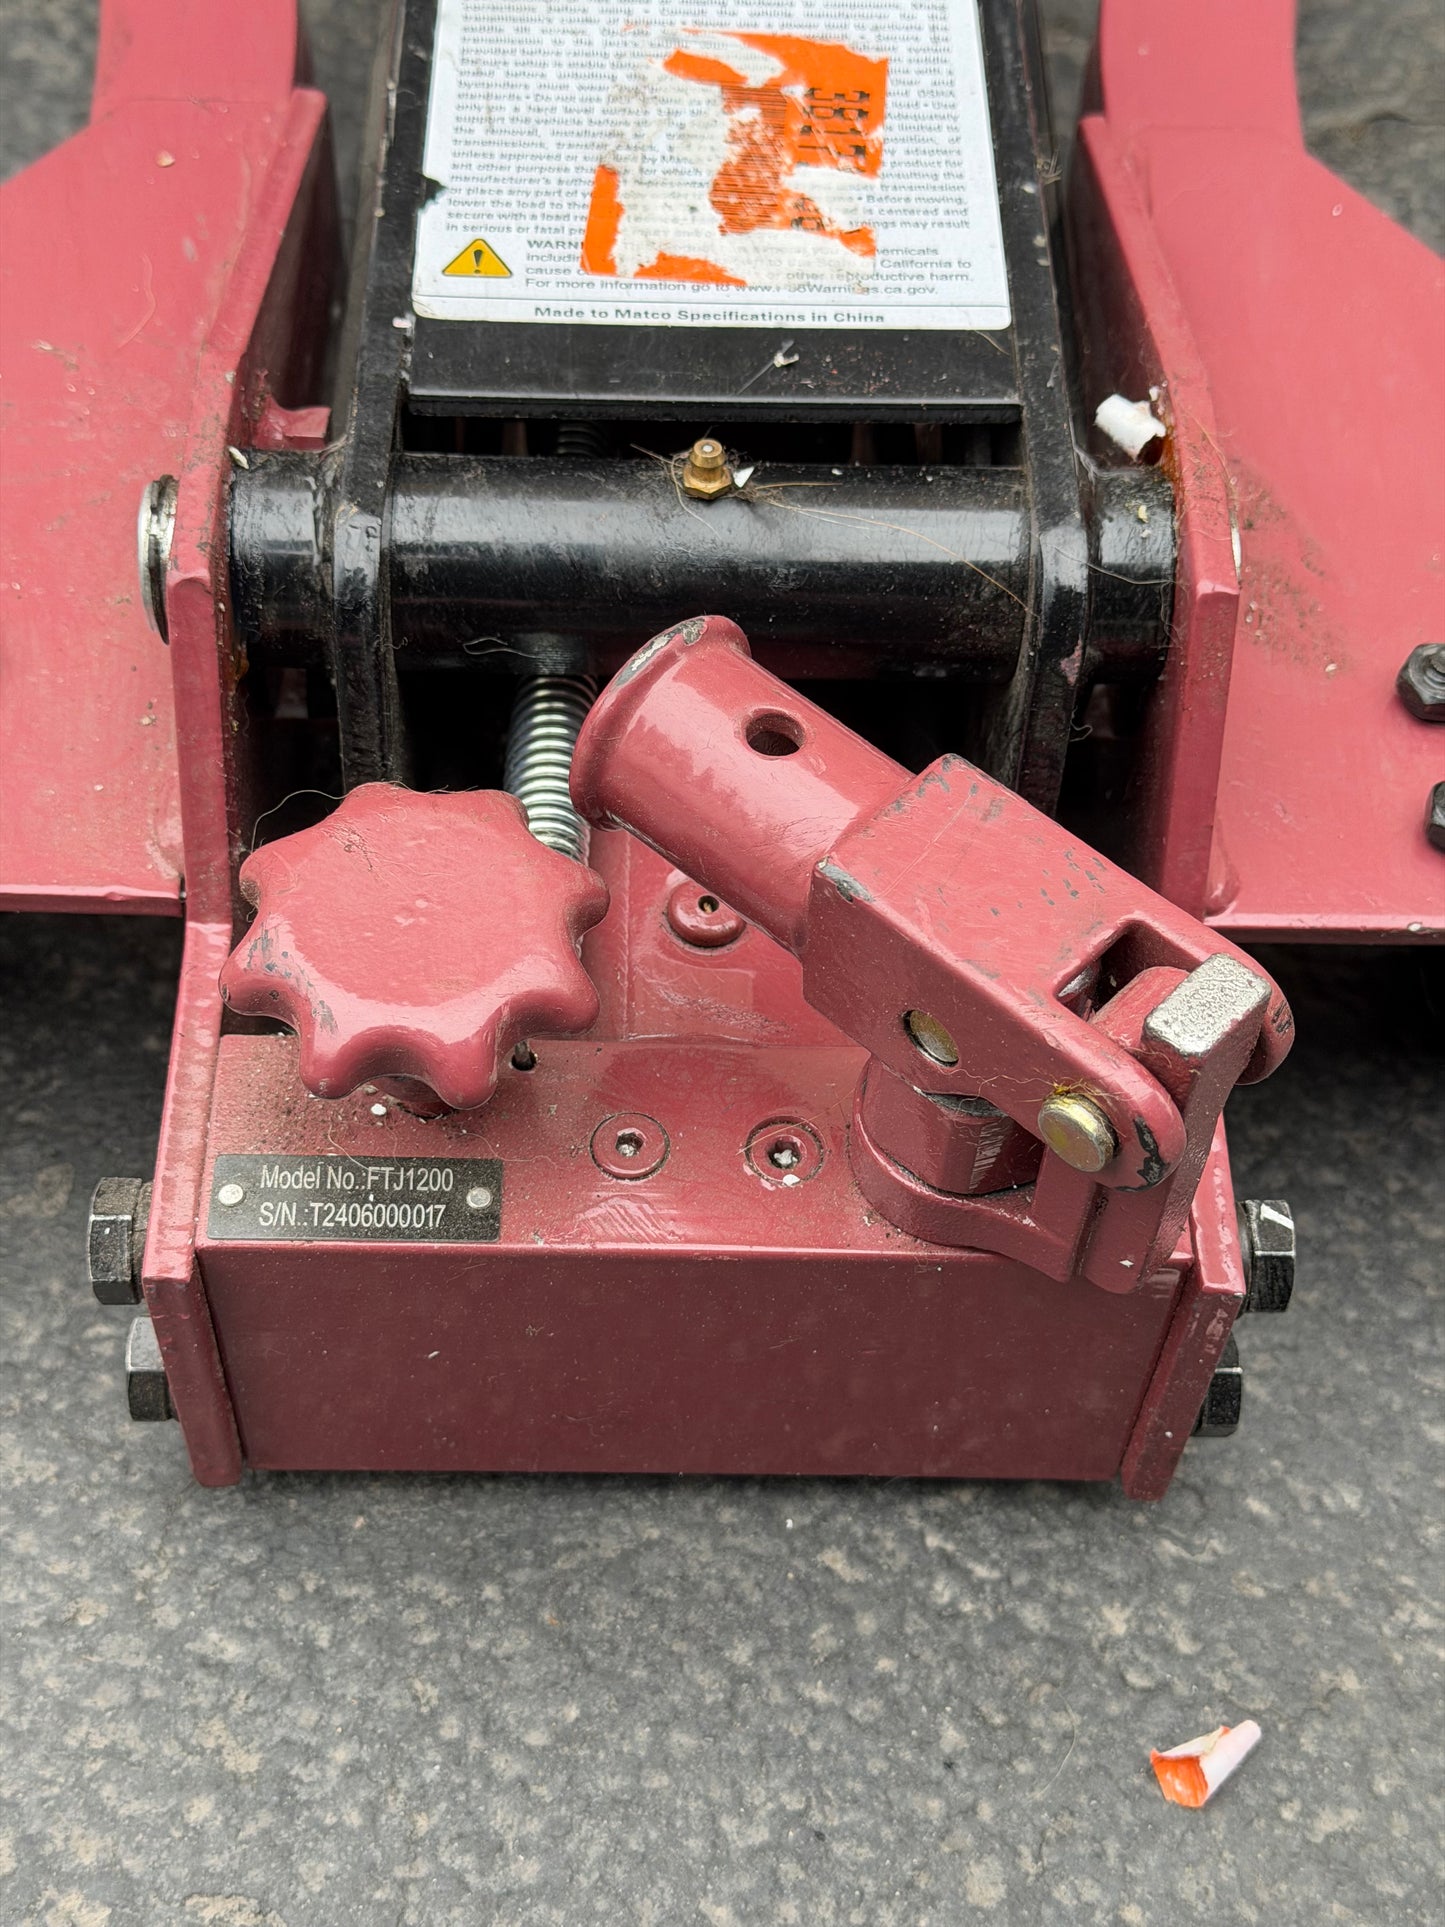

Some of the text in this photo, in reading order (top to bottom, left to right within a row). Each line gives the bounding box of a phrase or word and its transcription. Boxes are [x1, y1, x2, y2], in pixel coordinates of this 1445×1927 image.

[447, 198, 486, 208] lower
[491, 199, 512, 208] the
[517, 200, 546, 210] load
[549, 201, 563, 210] to
[878, 205, 939, 216] centered
[943, 207, 969, 217] and
[866, 194, 912, 204] Before
[446, 211, 495, 221] secure
[497, 211, 528, 222] with
[530, 213, 539, 222] a
[541, 212, 571, 222] load
[900, 220, 929, 230] may
[931, 220, 971, 230] result
[462, 223, 513, 234] serious
[516, 225, 530, 234] or
[534, 225, 565, 235] fatal
[880, 258, 951, 270] California
[957, 259, 972, 270] to
[525, 266, 572, 277] cause
[929, 271, 974, 283] harm.
[525, 278, 550, 289] For
[555, 279, 596, 290] more
[600, 279, 687, 292] information
[691, 282, 711, 295] go
[715, 281, 731, 293] to
[534, 306, 885, 324] Made to Matco Specifications in China
[260, 1164, 321, 1189] Model
